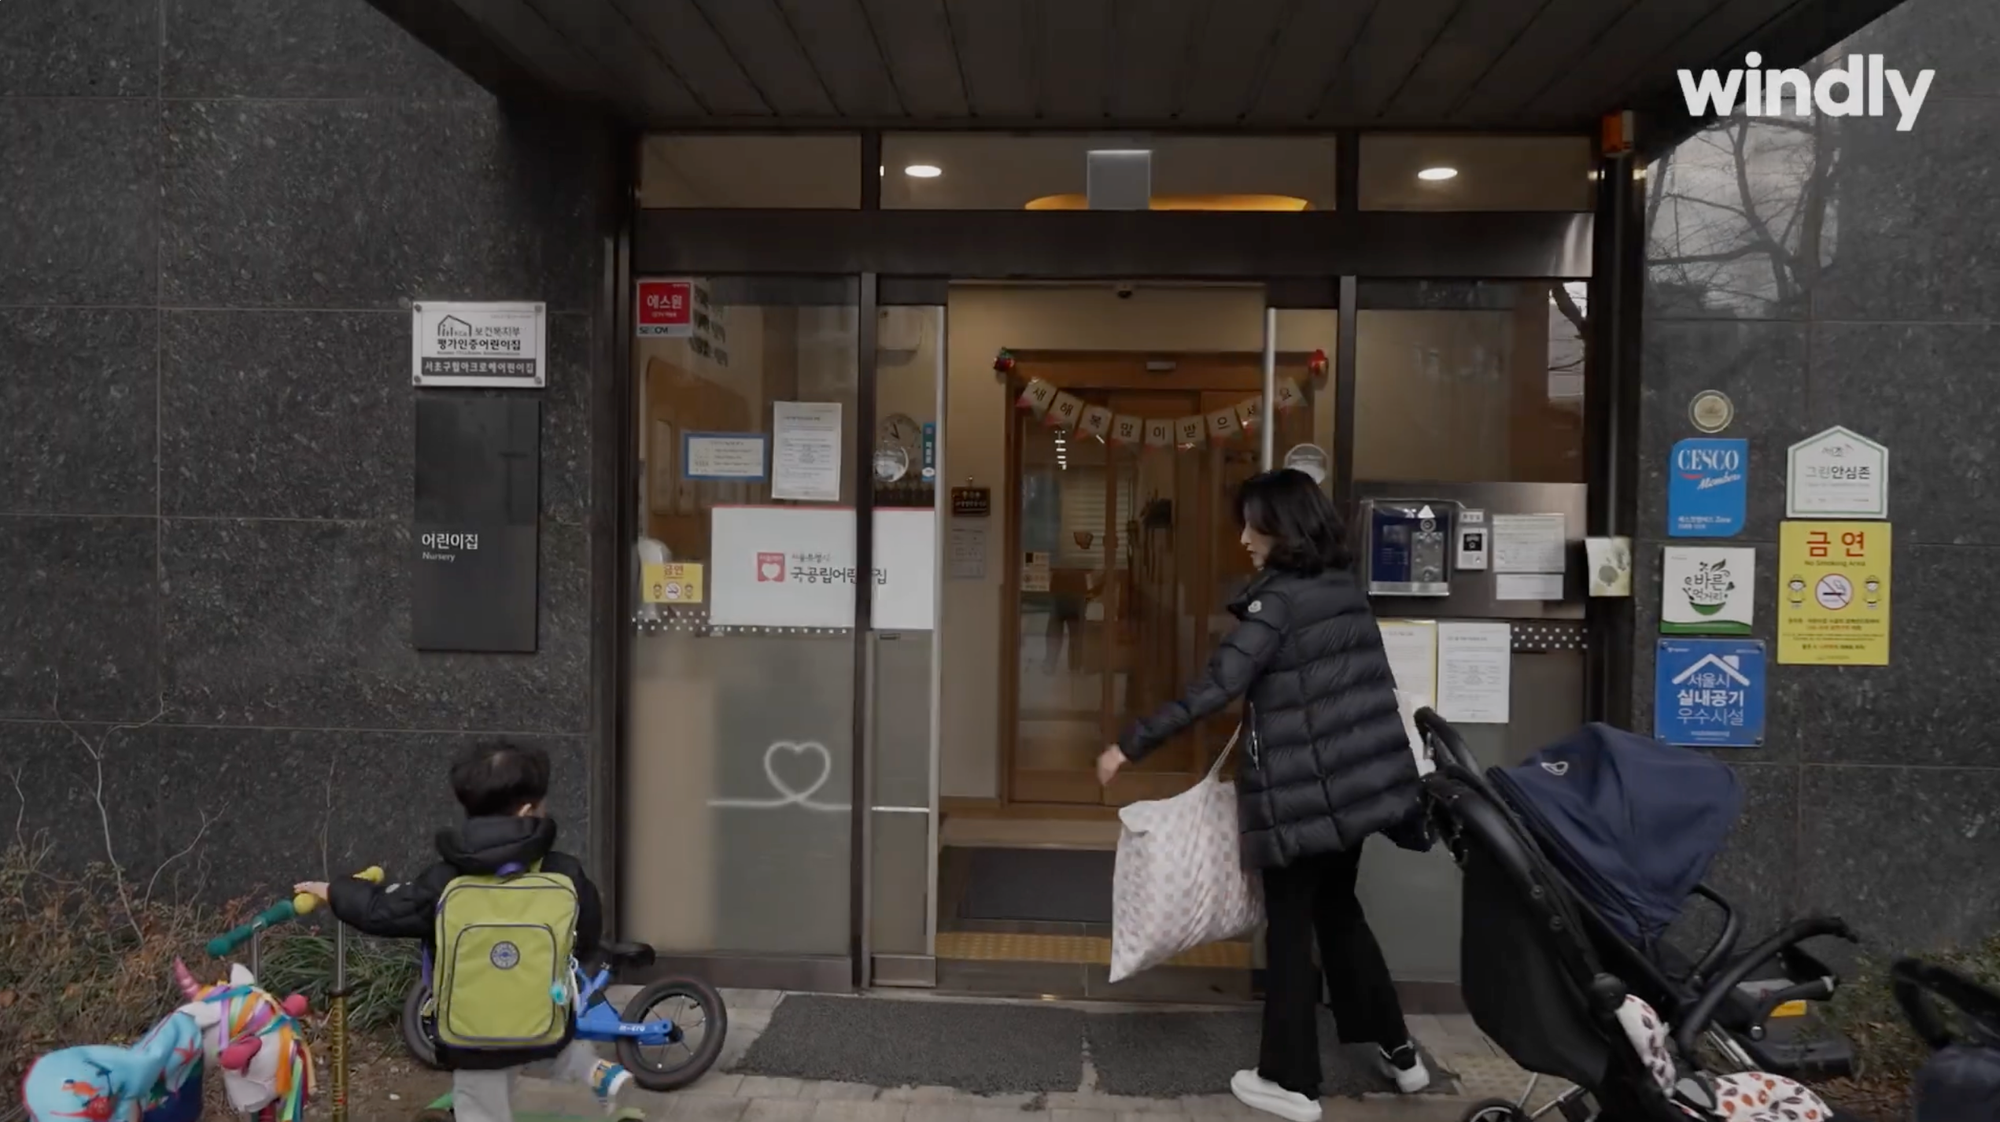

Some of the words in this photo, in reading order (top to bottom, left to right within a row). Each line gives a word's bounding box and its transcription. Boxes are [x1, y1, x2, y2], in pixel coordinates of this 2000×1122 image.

[647, 295, 682, 309] 에스원
[437, 338, 521, 351] 평가인증어린이집
[1678, 449, 1740, 471] CESCO
[1805, 465, 1871, 480] 그린안심존
[421, 533, 478, 550] 어린이집
[422, 552, 456, 562] Nursery
[663, 564, 684, 575] 금연
[1693, 571, 1726, 591] 바른
[1692, 588, 1723, 601] 먹거리
[1687, 672, 1731, 688] 서울시
[1677, 689, 1745, 707] 실내공기
[1676, 707, 1745, 726] 우수시설
